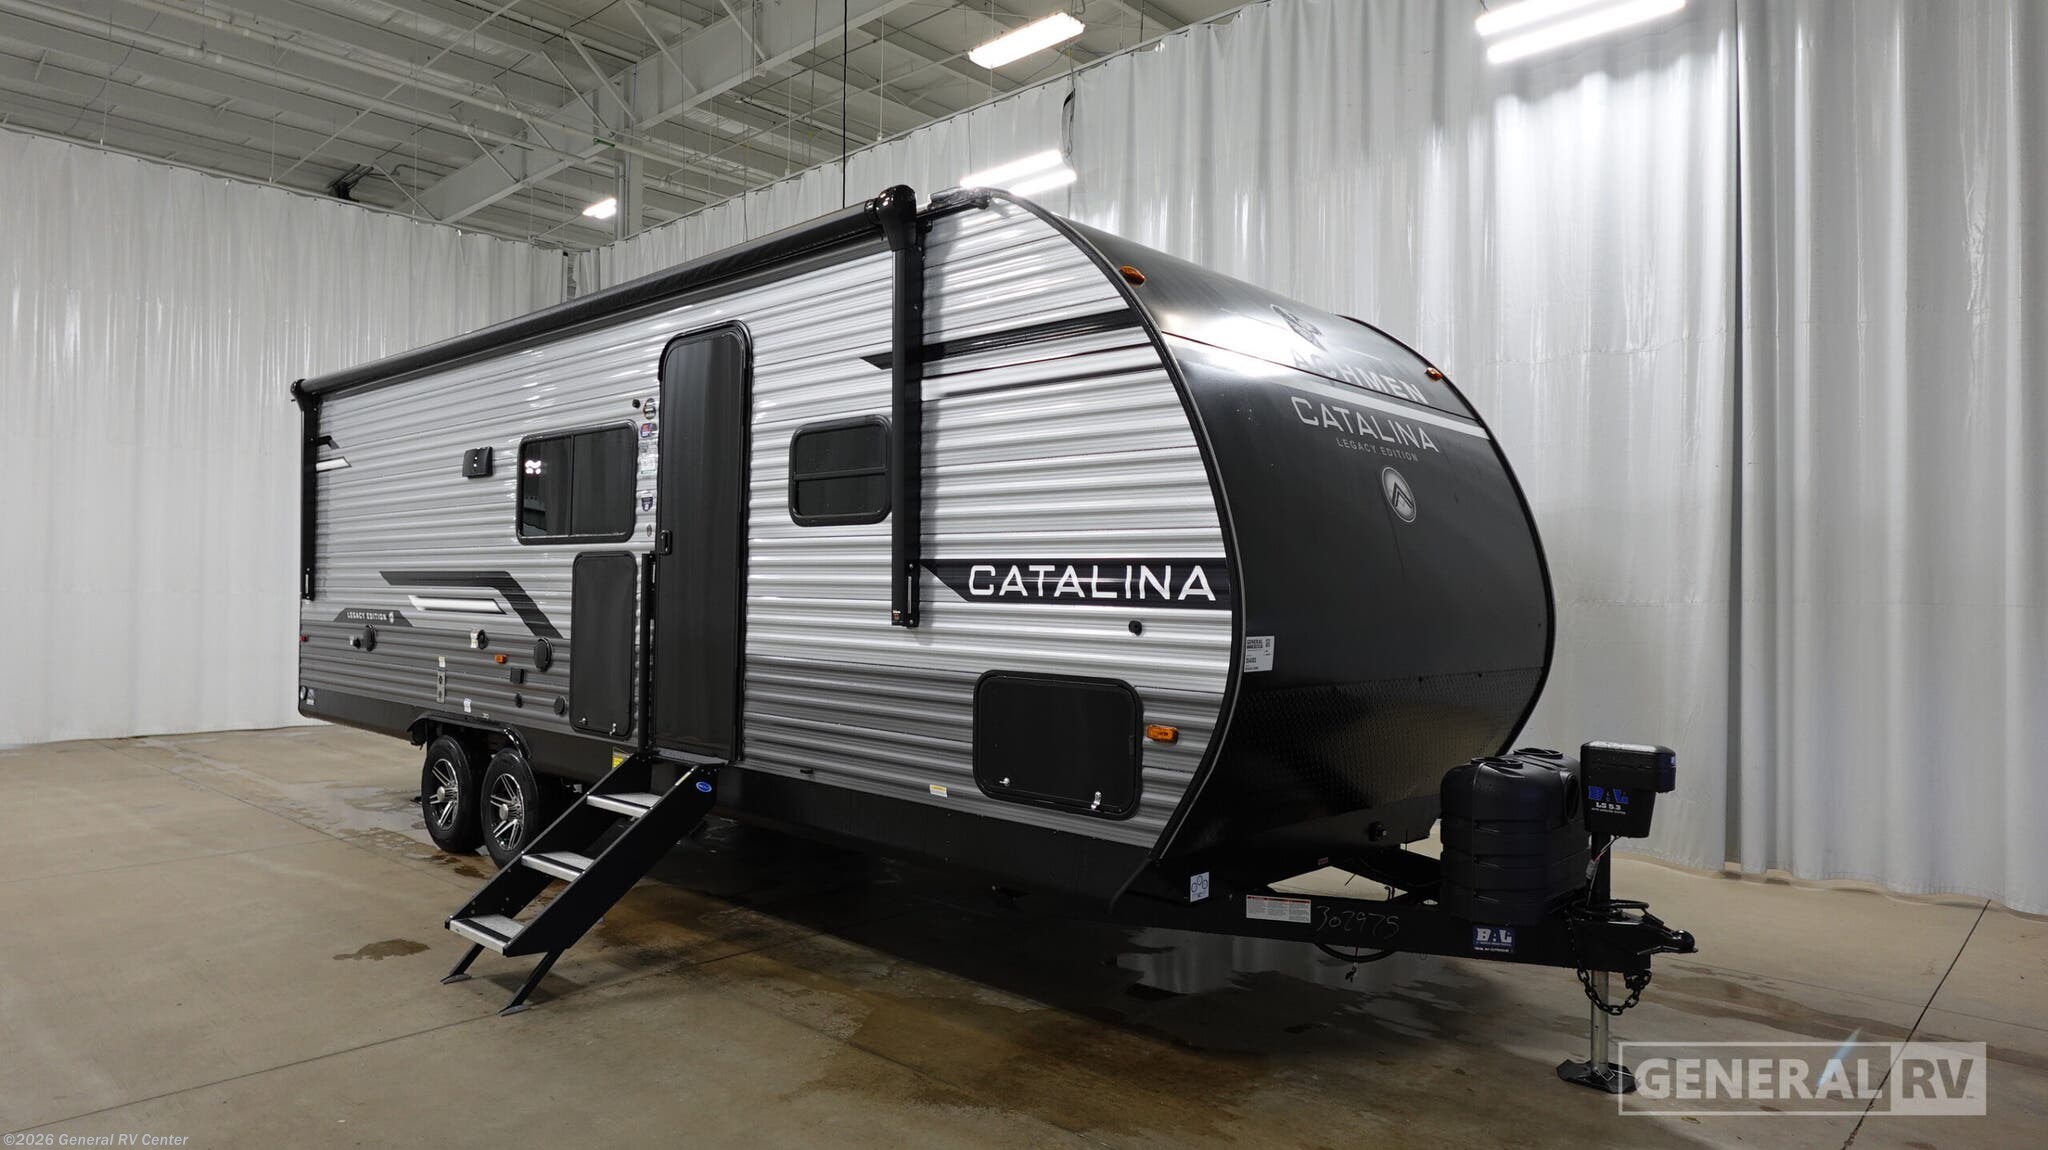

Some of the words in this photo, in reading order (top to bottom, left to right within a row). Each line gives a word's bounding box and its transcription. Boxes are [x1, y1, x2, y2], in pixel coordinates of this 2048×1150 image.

[1290, 396, 1440, 453] CATALINA
[1336, 437, 1376, 453] LEGACY
[1381, 446, 1418, 462] EDITION
[968, 564, 1217, 602] CATALINA
[346, 611, 366, 619] LEGACY
[366, 612, 387, 620] EDITION
